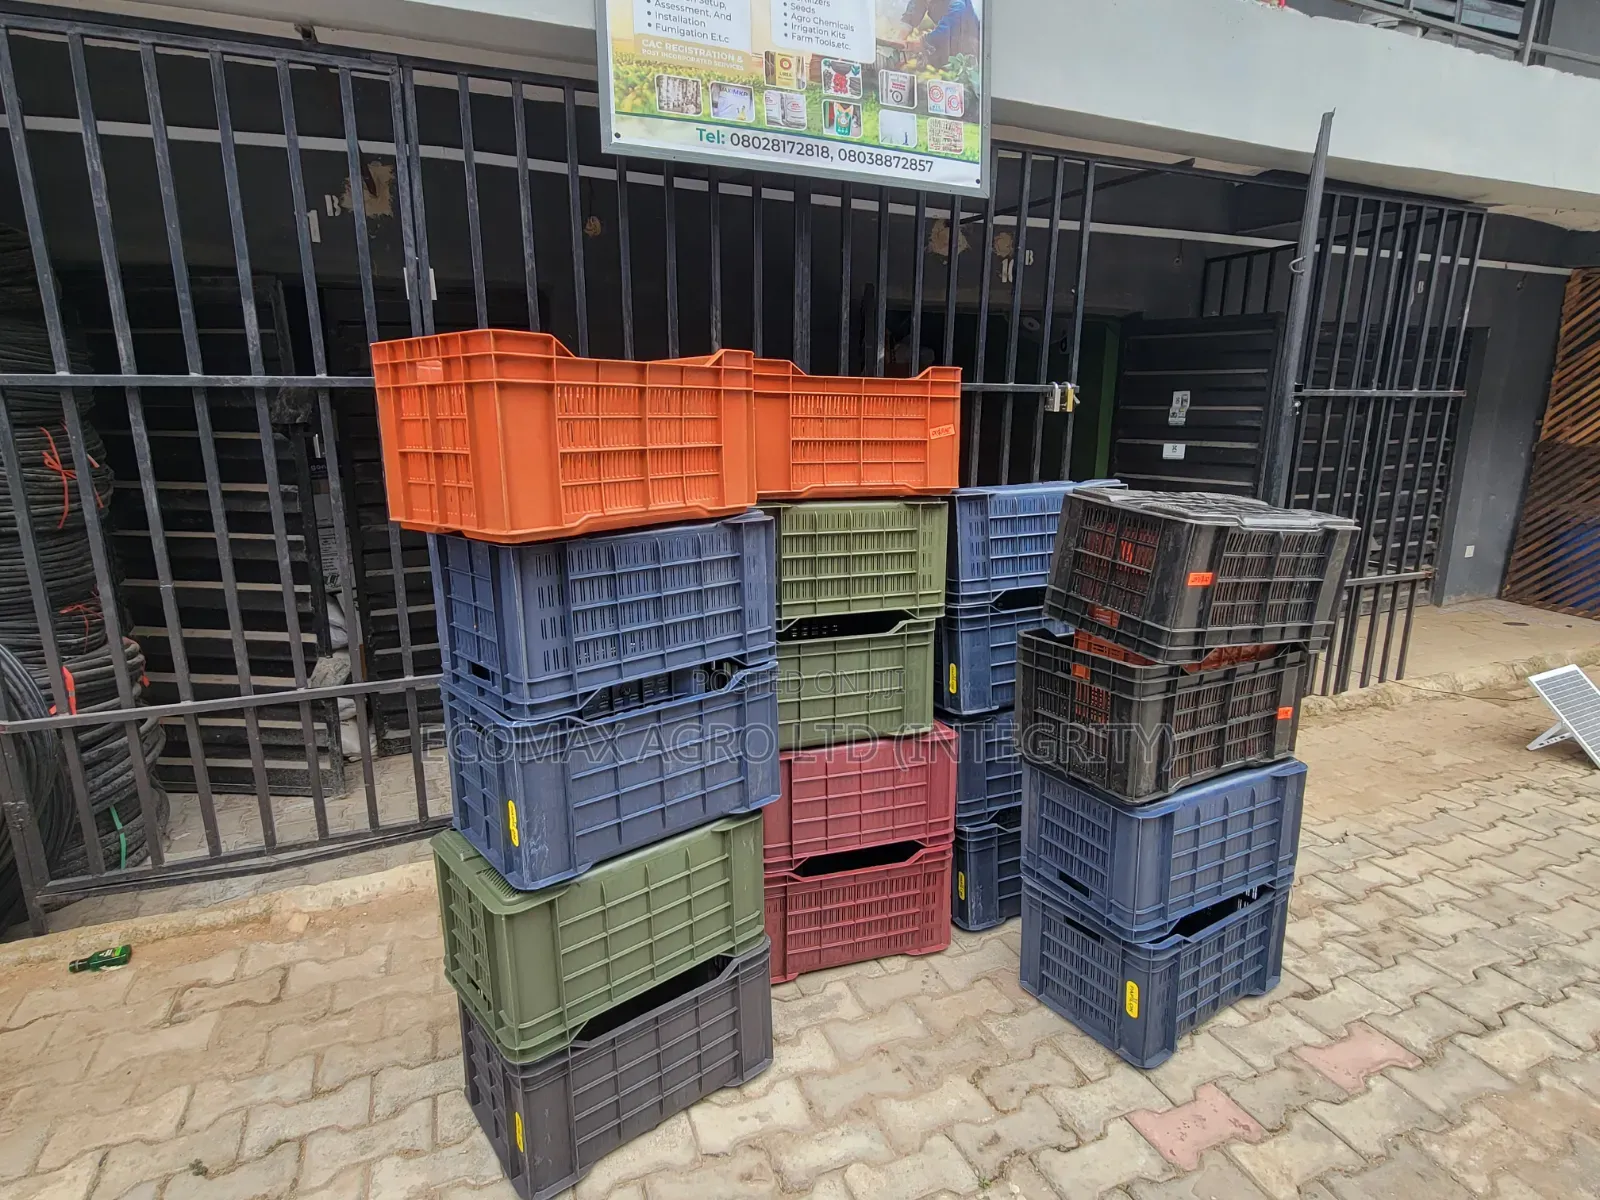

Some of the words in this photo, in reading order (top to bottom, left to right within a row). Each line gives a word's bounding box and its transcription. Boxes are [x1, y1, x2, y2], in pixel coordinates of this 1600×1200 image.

[655, 0, 712, 18] Assessment,
[714, 11, 732, 21] And
[790, 3, 816, 14] Seeds
[655, 11, 706, 28] Installation
[791, 13, 811, 23] Agro
[812, 17, 855, 32] Chemicals
[655, 23, 709, 40] Fumigation
[791, 22, 829, 36] Irrigation
[830, 30, 846, 40] Kits
[791, 33, 813, 43] Farm
[642, 39, 663, 49] CAC
[665, 43, 735, 62] REGISTRATION
[737, 55, 744, 63] &
[642, 48, 660, 57] POST
[696, 127, 725, 145] Tel:
[730, 132, 834, 162] 08028172818,
[837, 148, 934, 173] 08038872857
